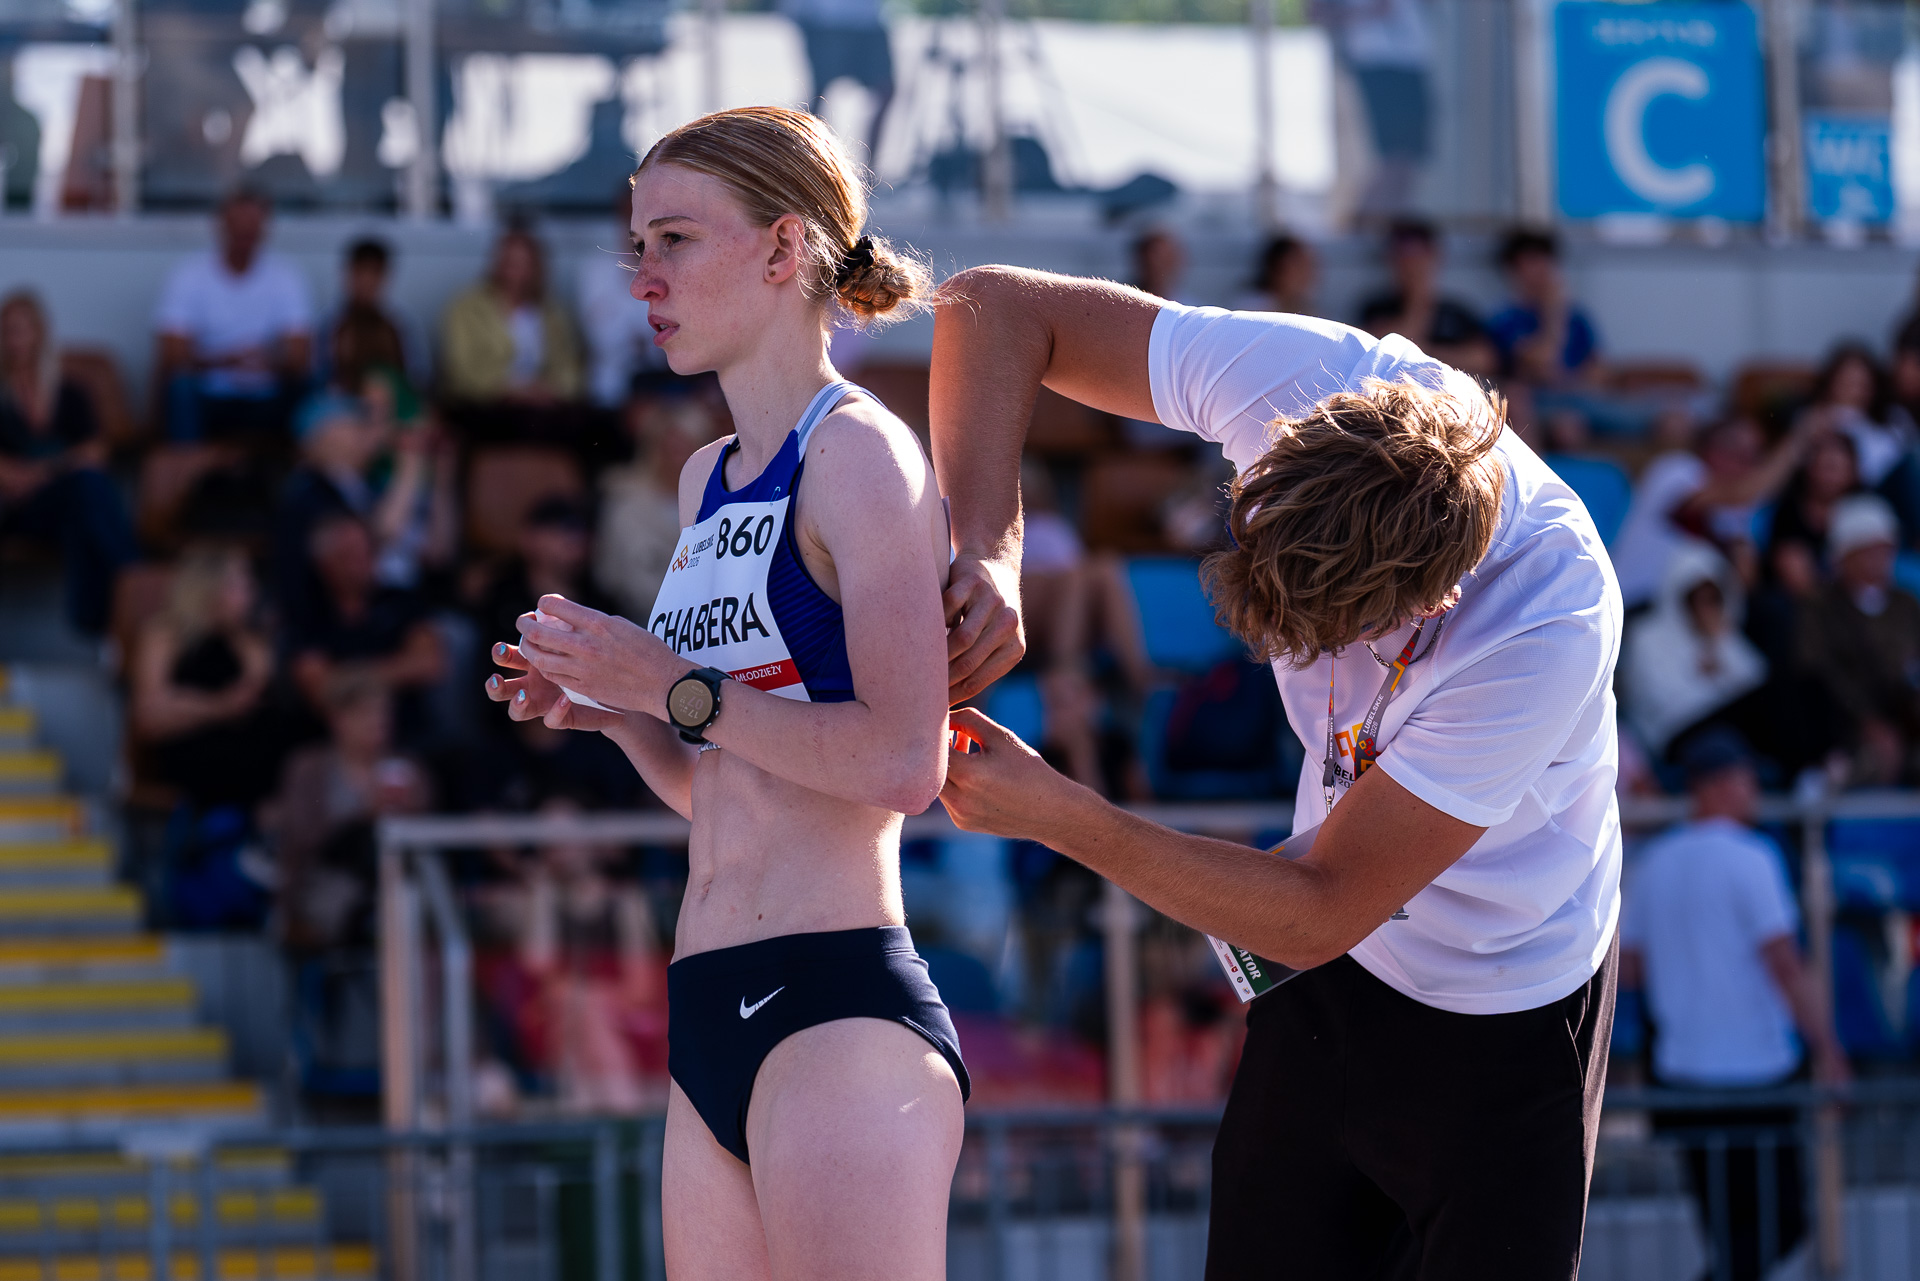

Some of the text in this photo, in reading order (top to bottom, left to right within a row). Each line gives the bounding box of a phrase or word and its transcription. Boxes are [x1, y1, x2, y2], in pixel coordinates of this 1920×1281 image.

[1603, 56, 1716, 206] C
[716, 515, 774, 560] 860
[734, 664, 782, 682] MŁODZIEŻY
[1363, 694, 1384, 734] LUBELSKIE
